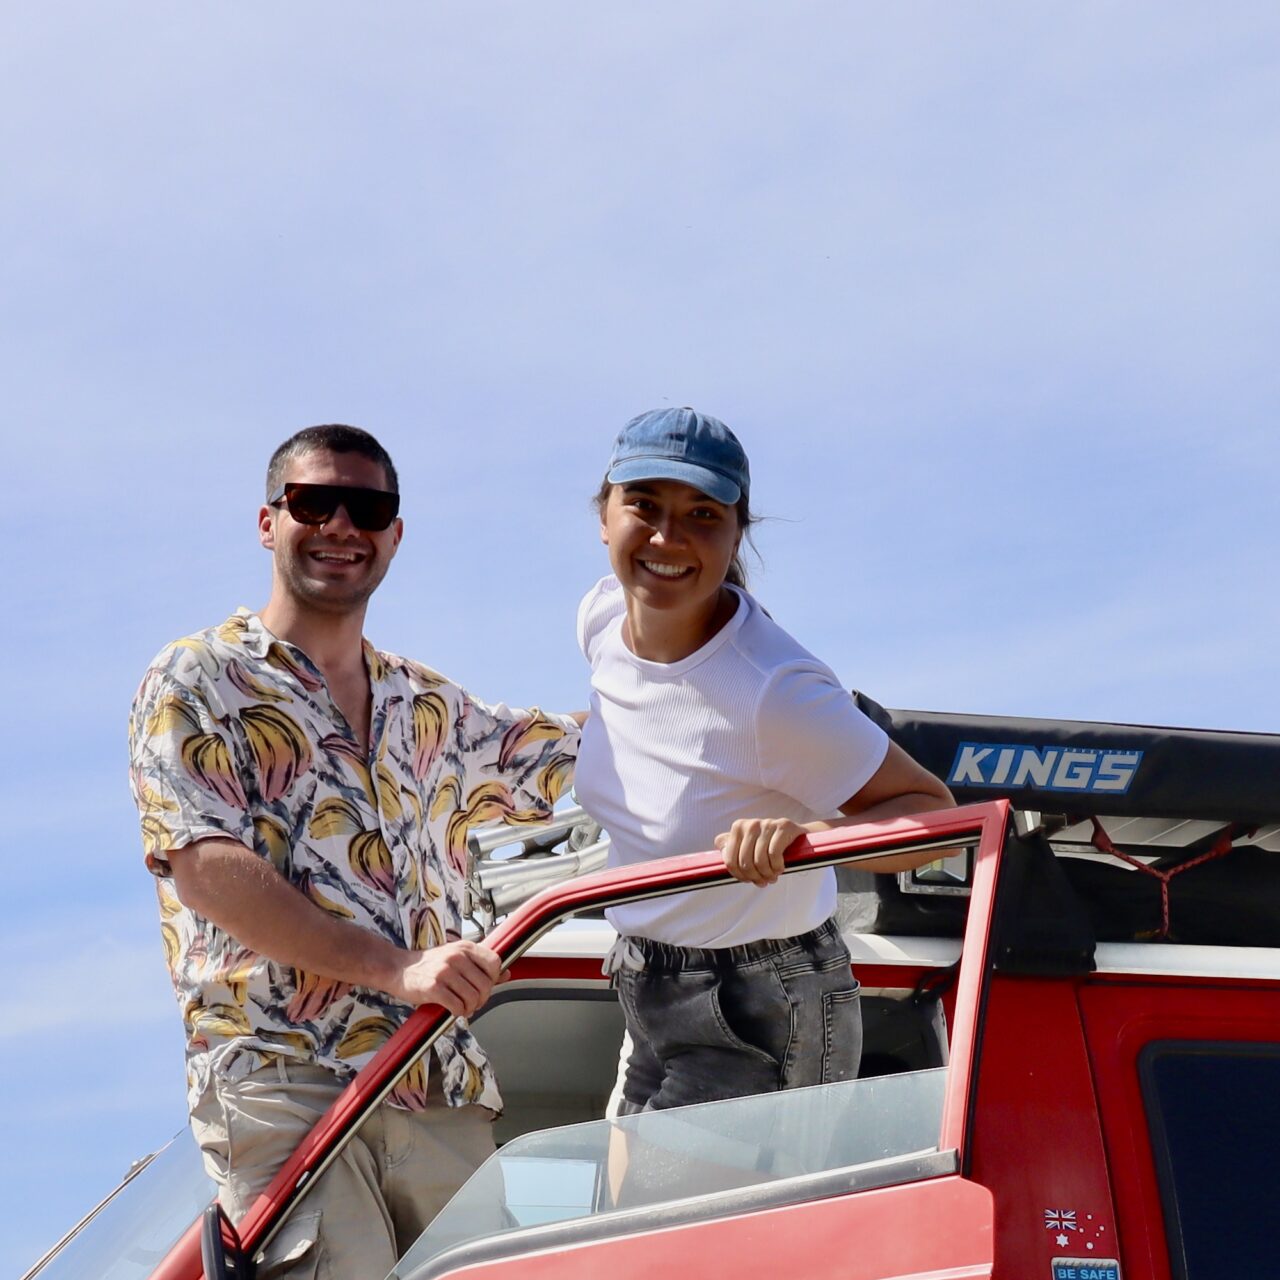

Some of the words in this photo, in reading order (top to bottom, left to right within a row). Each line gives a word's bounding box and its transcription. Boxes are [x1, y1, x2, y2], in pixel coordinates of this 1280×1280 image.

[951, 746, 1141, 790] KINGS
[1057, 1269, 1076, 1279] BE
[1080, 1269, 1116, 1280] SAFE
